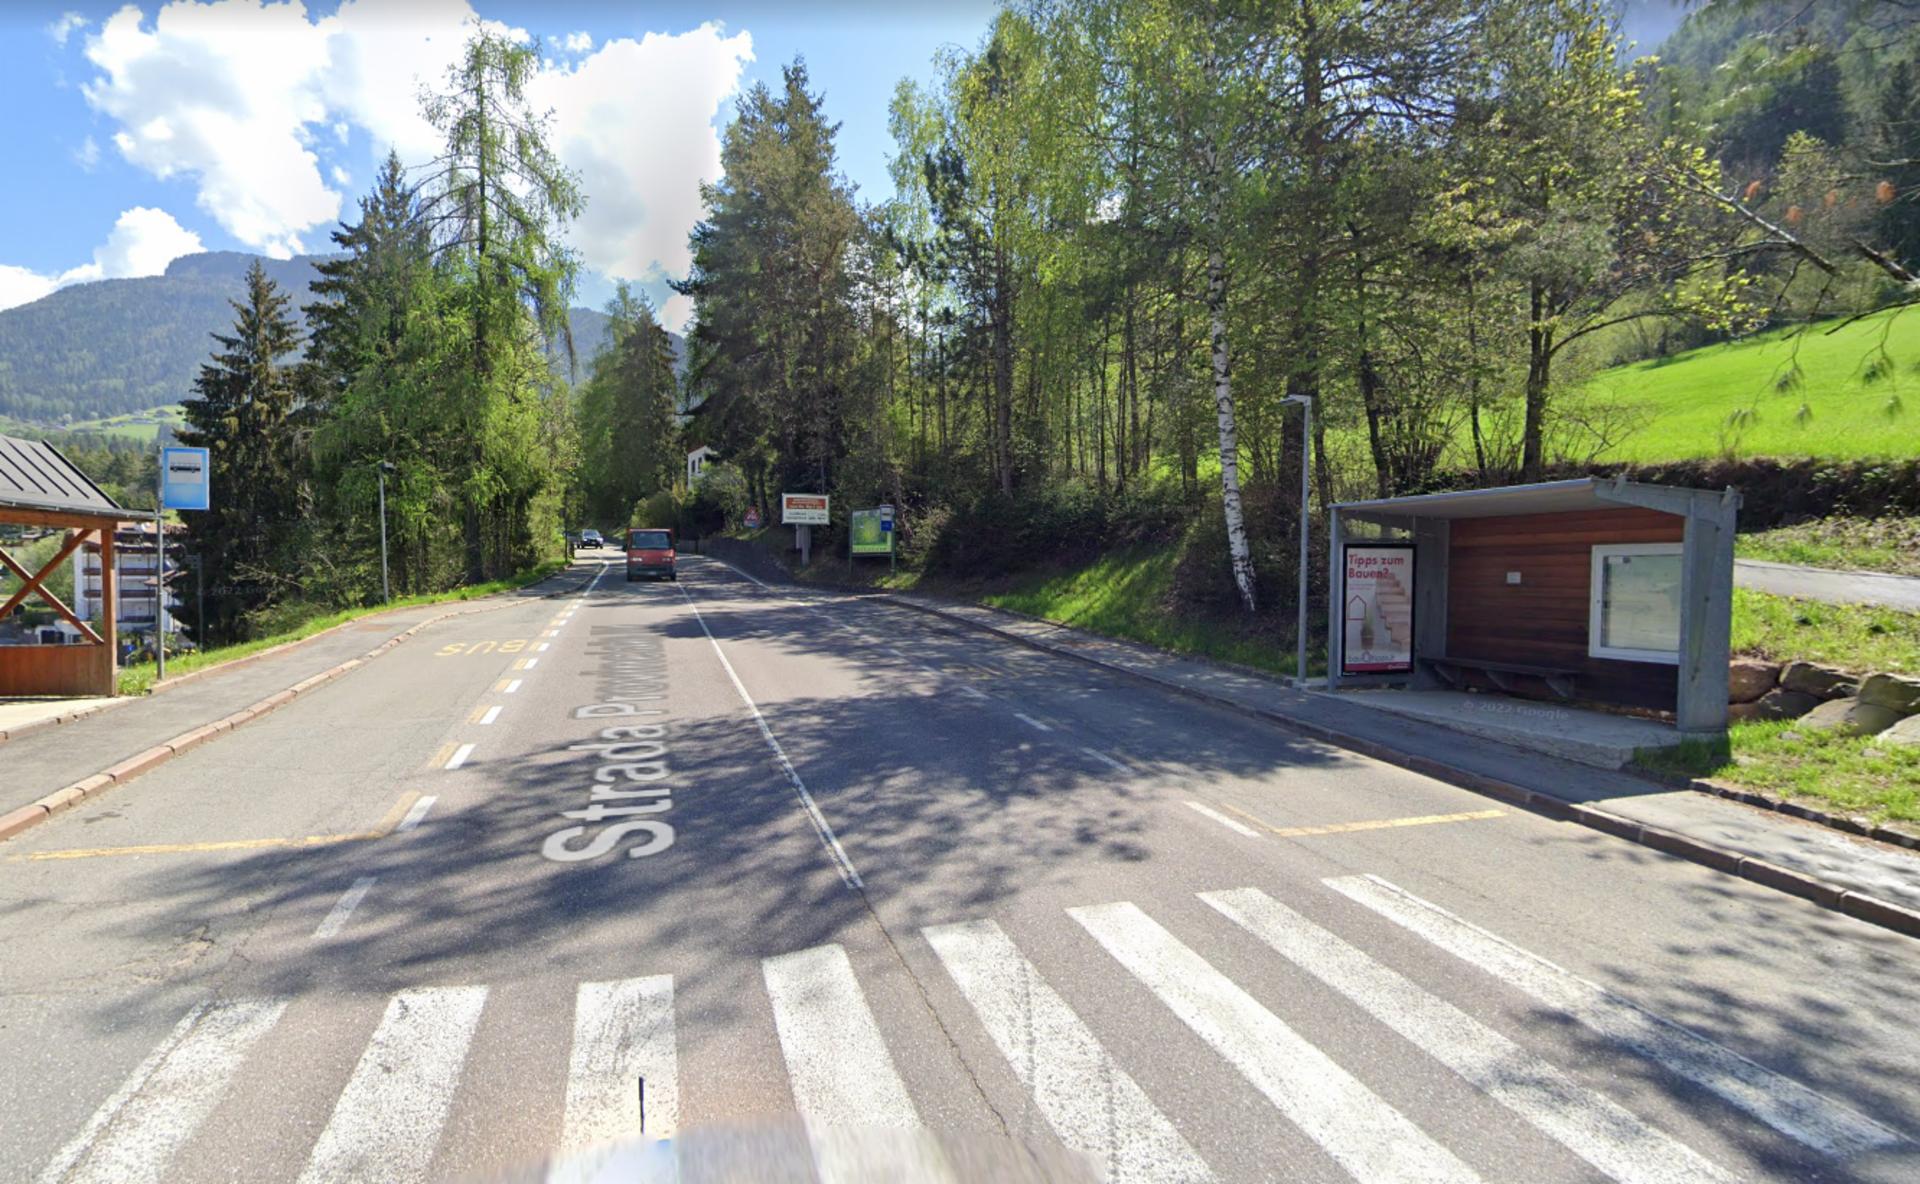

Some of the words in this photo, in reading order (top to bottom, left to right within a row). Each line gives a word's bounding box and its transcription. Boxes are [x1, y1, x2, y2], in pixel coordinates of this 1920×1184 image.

[1348, 553, 1378, 568] Tipps
[1380, 556, 1405, 566] zum
[1348, 568, 1389, 579] Bauen?
[434, 639, 529, 656] BUS
